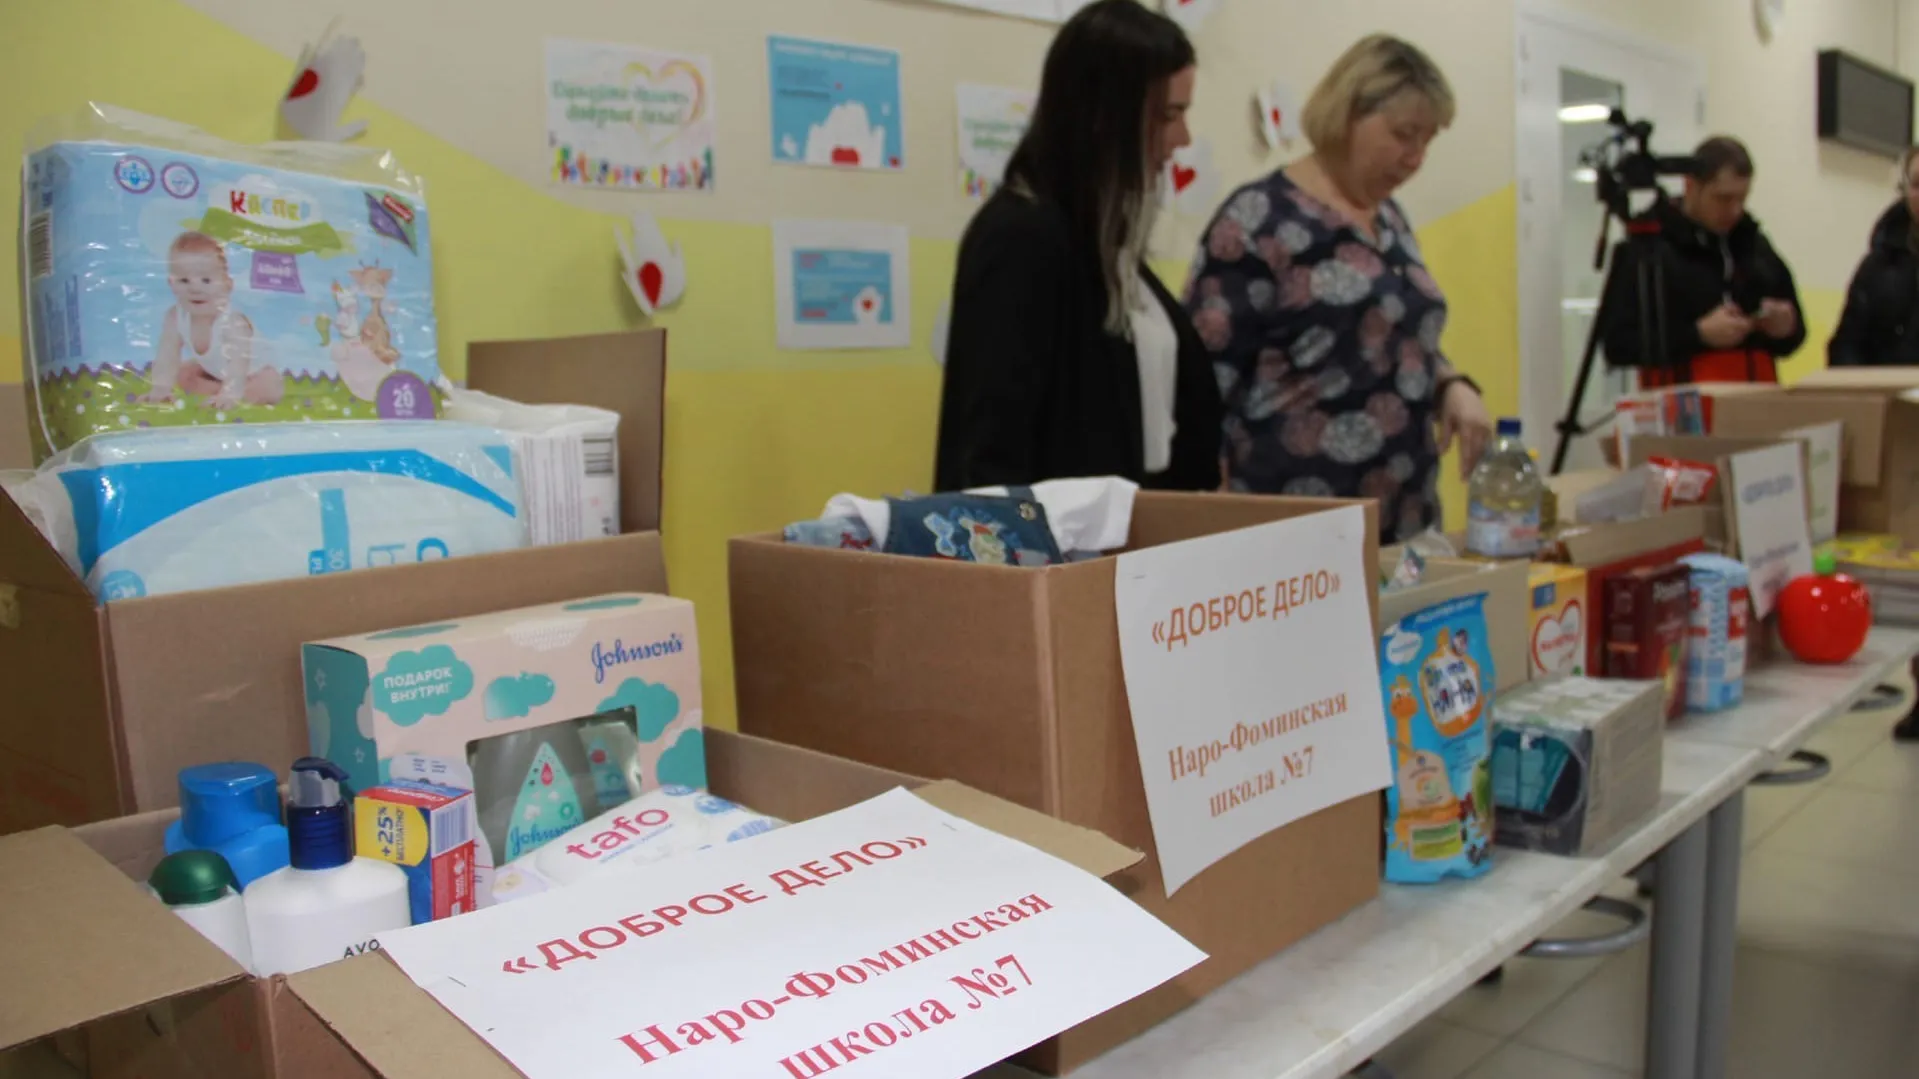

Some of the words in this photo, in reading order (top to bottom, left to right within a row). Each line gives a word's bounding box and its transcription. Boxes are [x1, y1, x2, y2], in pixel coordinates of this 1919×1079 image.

[393, 388, 415, 408] 20
[1152, 586, 1266, 652] «ДОБРОЕ
[1272, 569, 1341, 621] ДЕЛО»
[383, 667, 453, 689] ПОДАРОК
[591, 633, 683, 684] Johnson's
[1168, 693, 1348, 781] Наро-Фоминская
[1209, 766, 1275, 818] школа
[1280, 745, 1314, 786] №7
[566, 809, 669, 860] tafo
[502, 883, 768, 974] «ДОБРОЕ
[768, 836, 927, 895] ДЕЛО»
[343, 939, 381, 959] AVO
[615, 893, 1055, 1066] Наро-Фоминская
[776, 996, 957, 1079] школа
[947, 954, 1034, 1011] №7
